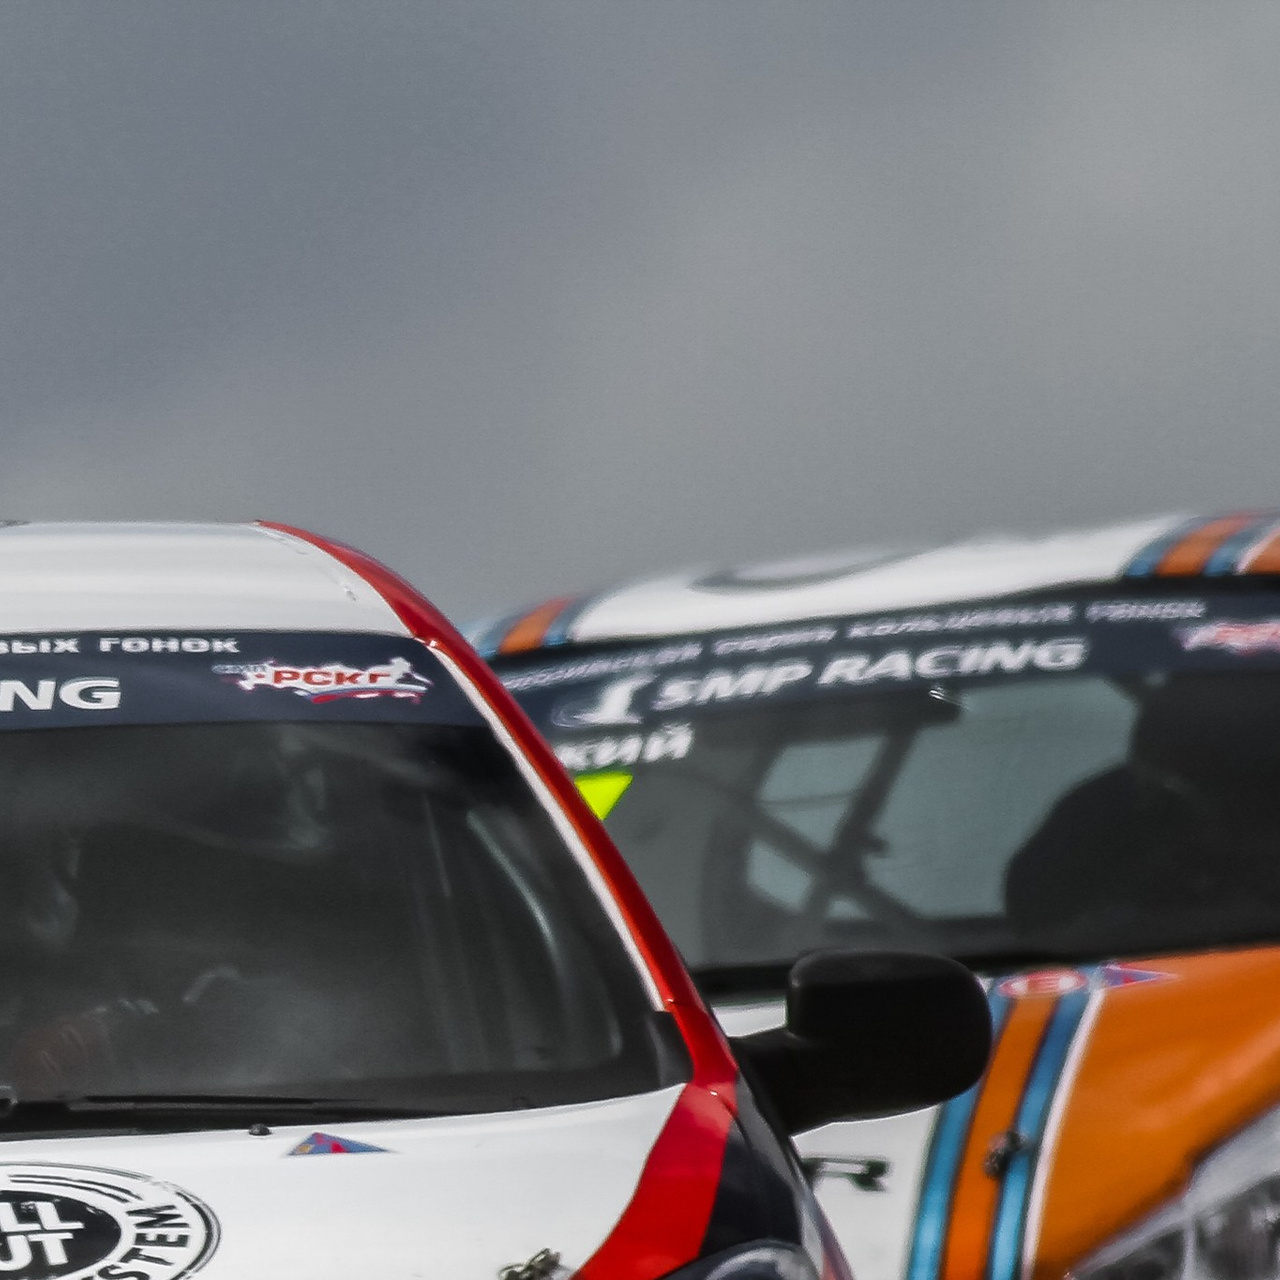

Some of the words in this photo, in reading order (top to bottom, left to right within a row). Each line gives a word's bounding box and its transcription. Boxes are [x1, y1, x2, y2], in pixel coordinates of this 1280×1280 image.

[99, 637, 241, 653] гонок
[651, 658, 814, 711] SMP
[818, 635, 1088, 686] RACING
